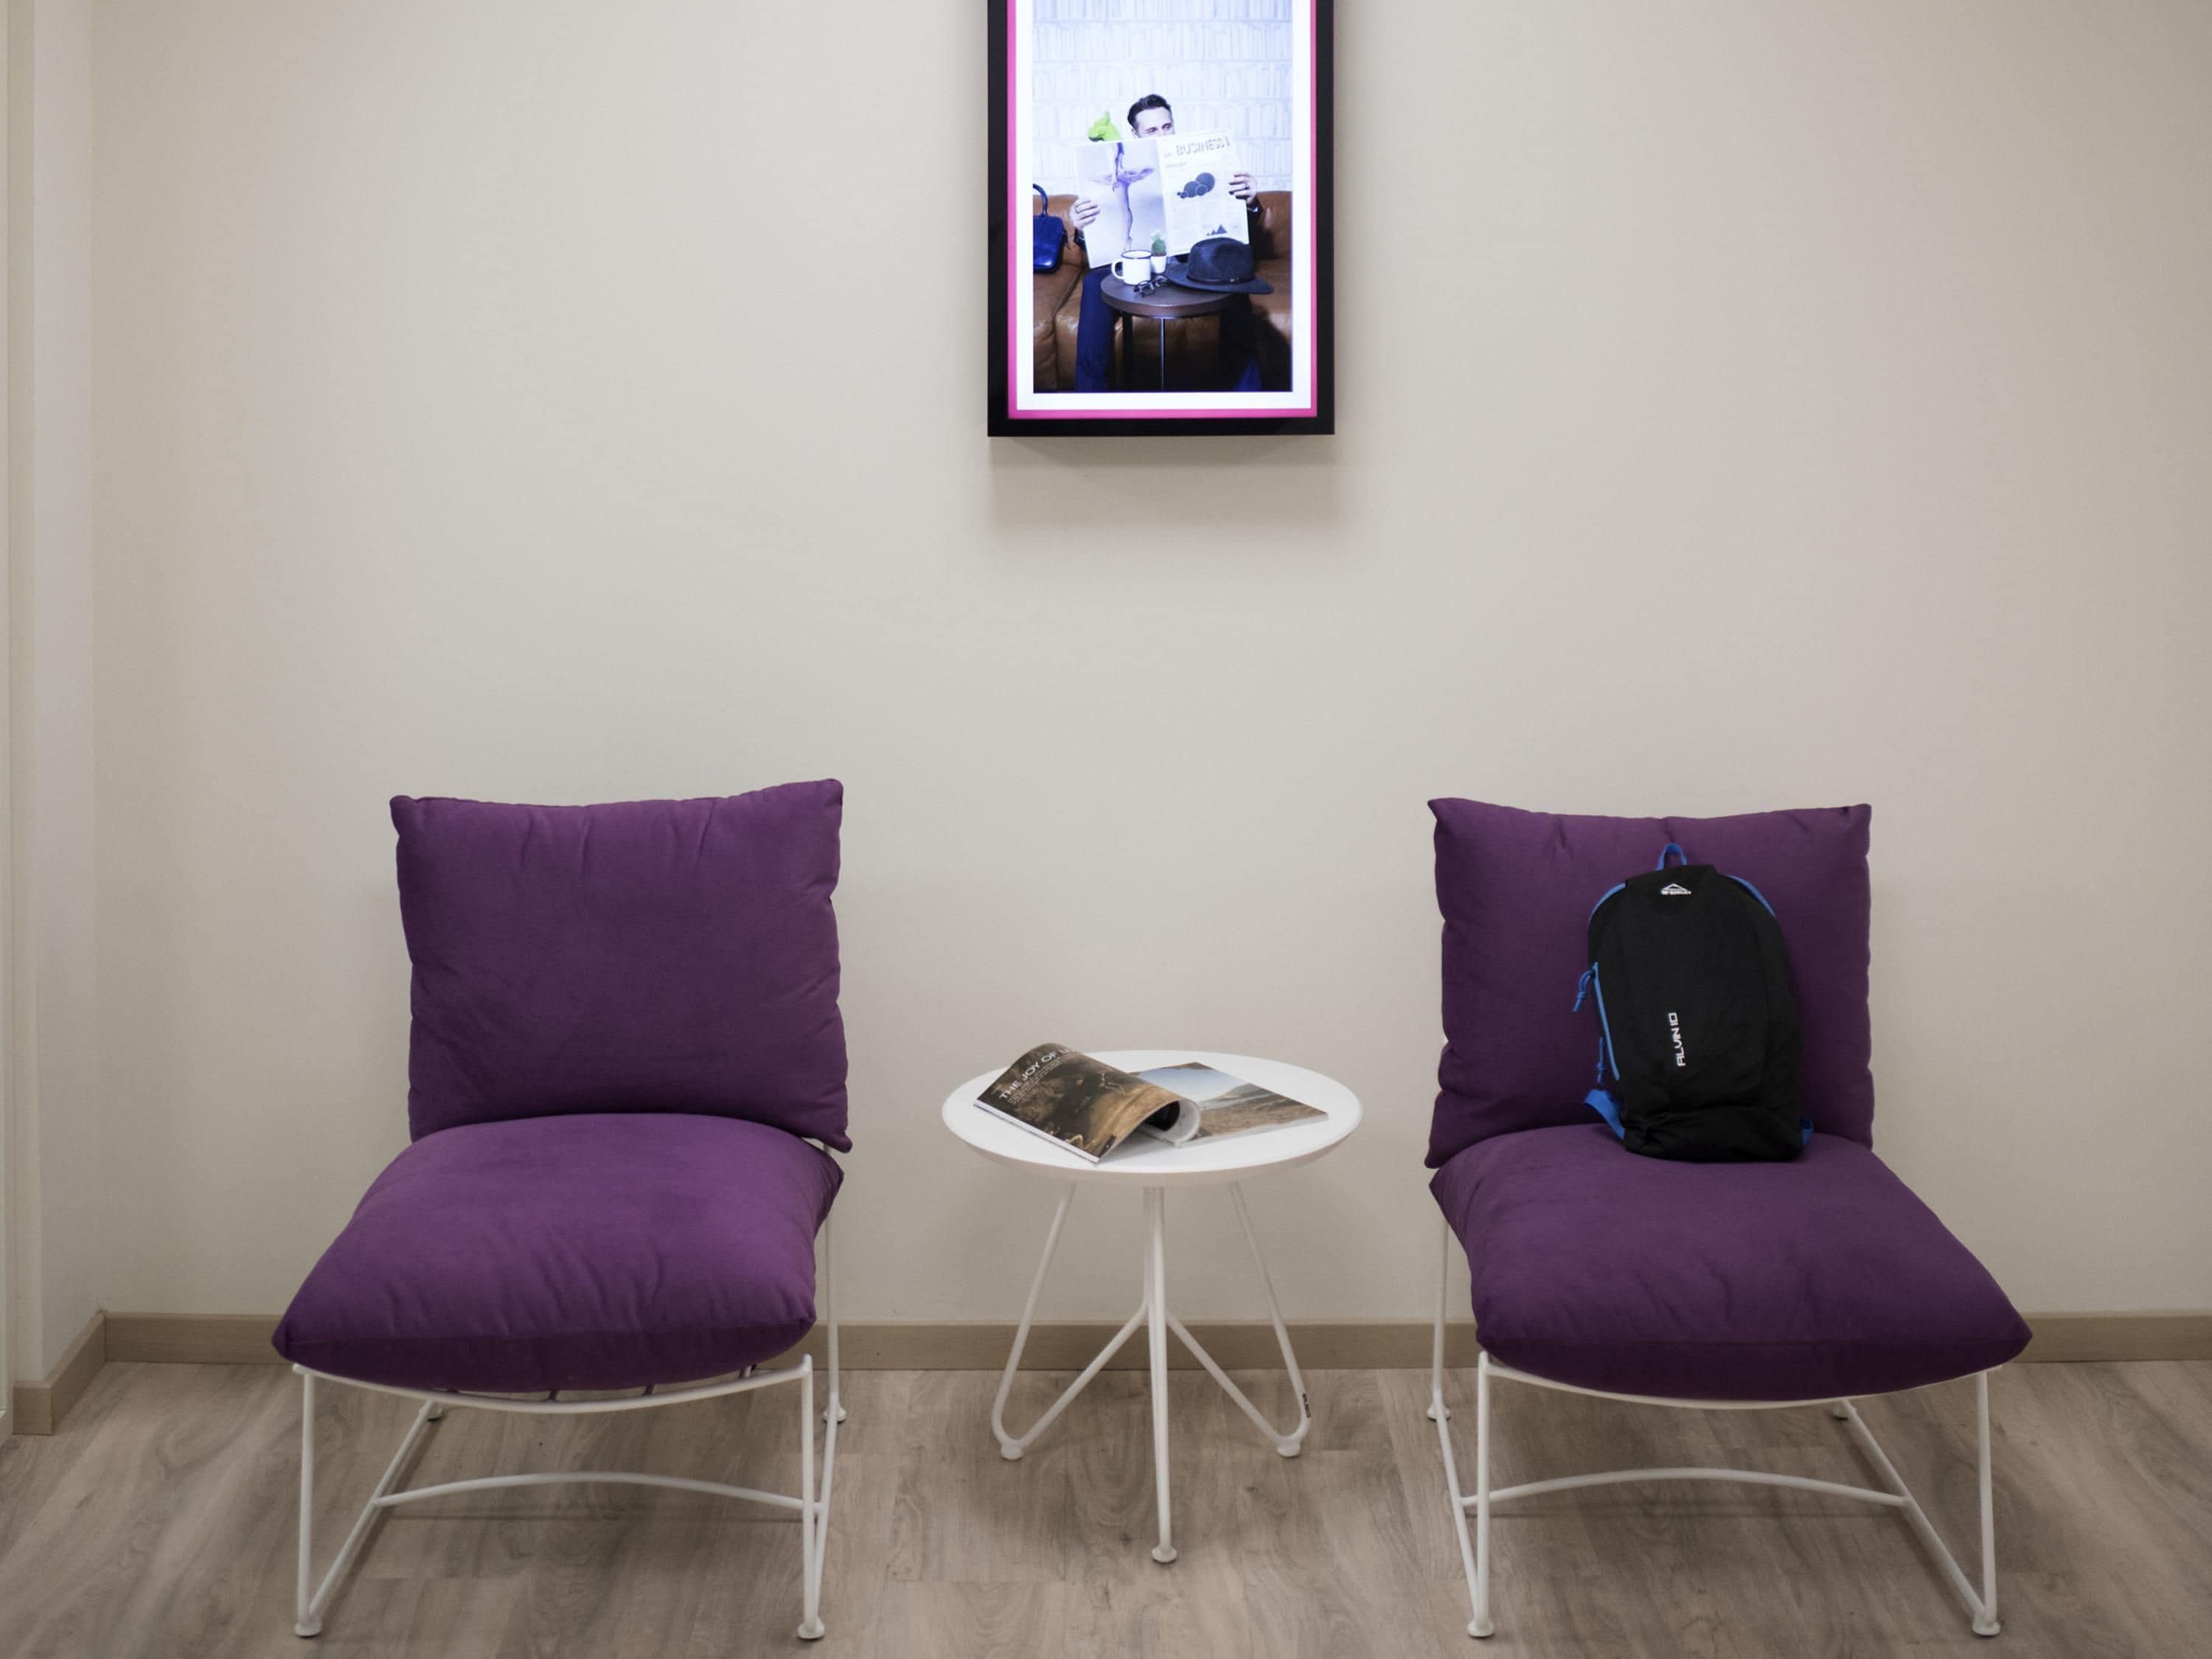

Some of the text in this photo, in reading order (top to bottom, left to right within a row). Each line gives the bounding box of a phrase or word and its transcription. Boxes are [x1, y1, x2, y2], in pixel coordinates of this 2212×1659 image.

[1671, 1027, 1686, 1067] ALVIN
[998, 1080, 1022, 1099] THE
[1021, 1062, 1040, 1081] JOY
[1041, 1051, 1057, 1062] OF
